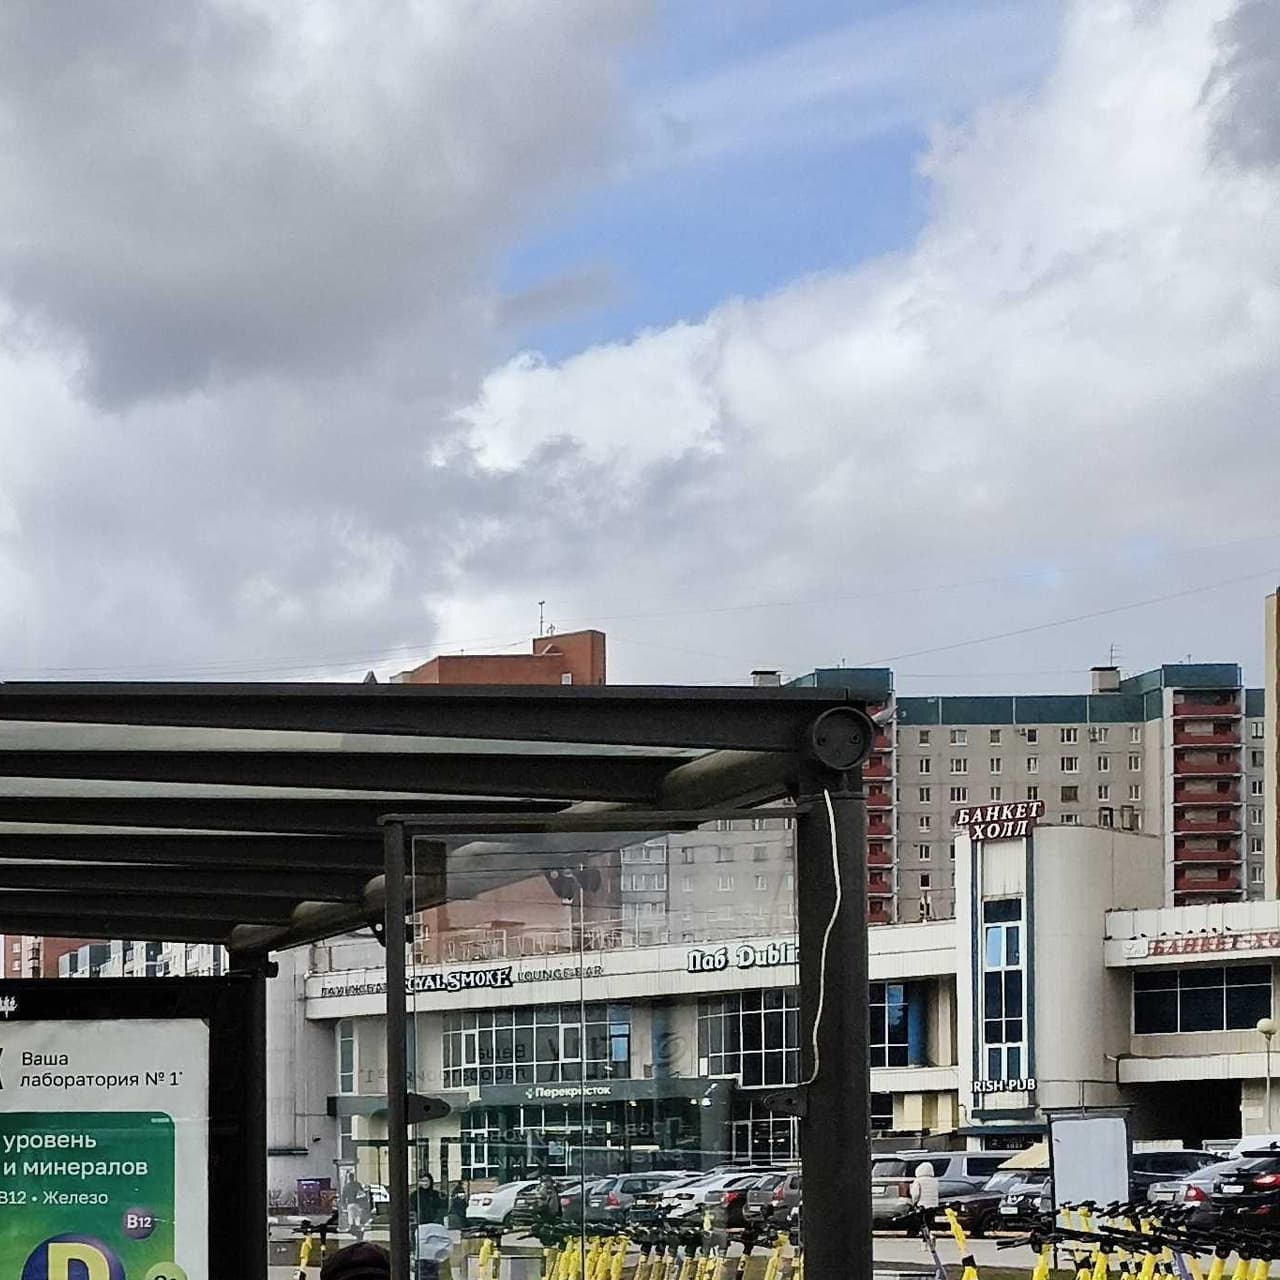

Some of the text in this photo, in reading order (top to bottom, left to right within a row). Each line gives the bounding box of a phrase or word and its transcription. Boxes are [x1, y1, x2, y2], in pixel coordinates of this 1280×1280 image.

[957, 802, 1041, 825] БАНКЕТ
[971, 820, 1029, 840] ХОЛЛ
[688, 947, 729, 972] Паб
[406, 967, 512, 993] OYAL SMOKE
[22, 1052, 69, 1067] Ваша
[20, 1072, 139, 1089] лаборатория
[145, 1072, 165, 1086] №
[1008, 1078, 1036, 1091] PUB
[4, 1134, 97, 1153] уровень
[3, 1160, 17, 1176] и
[23, 1160, 148, 1179] минералов
[42, 1191, 109, 1205] Железо
